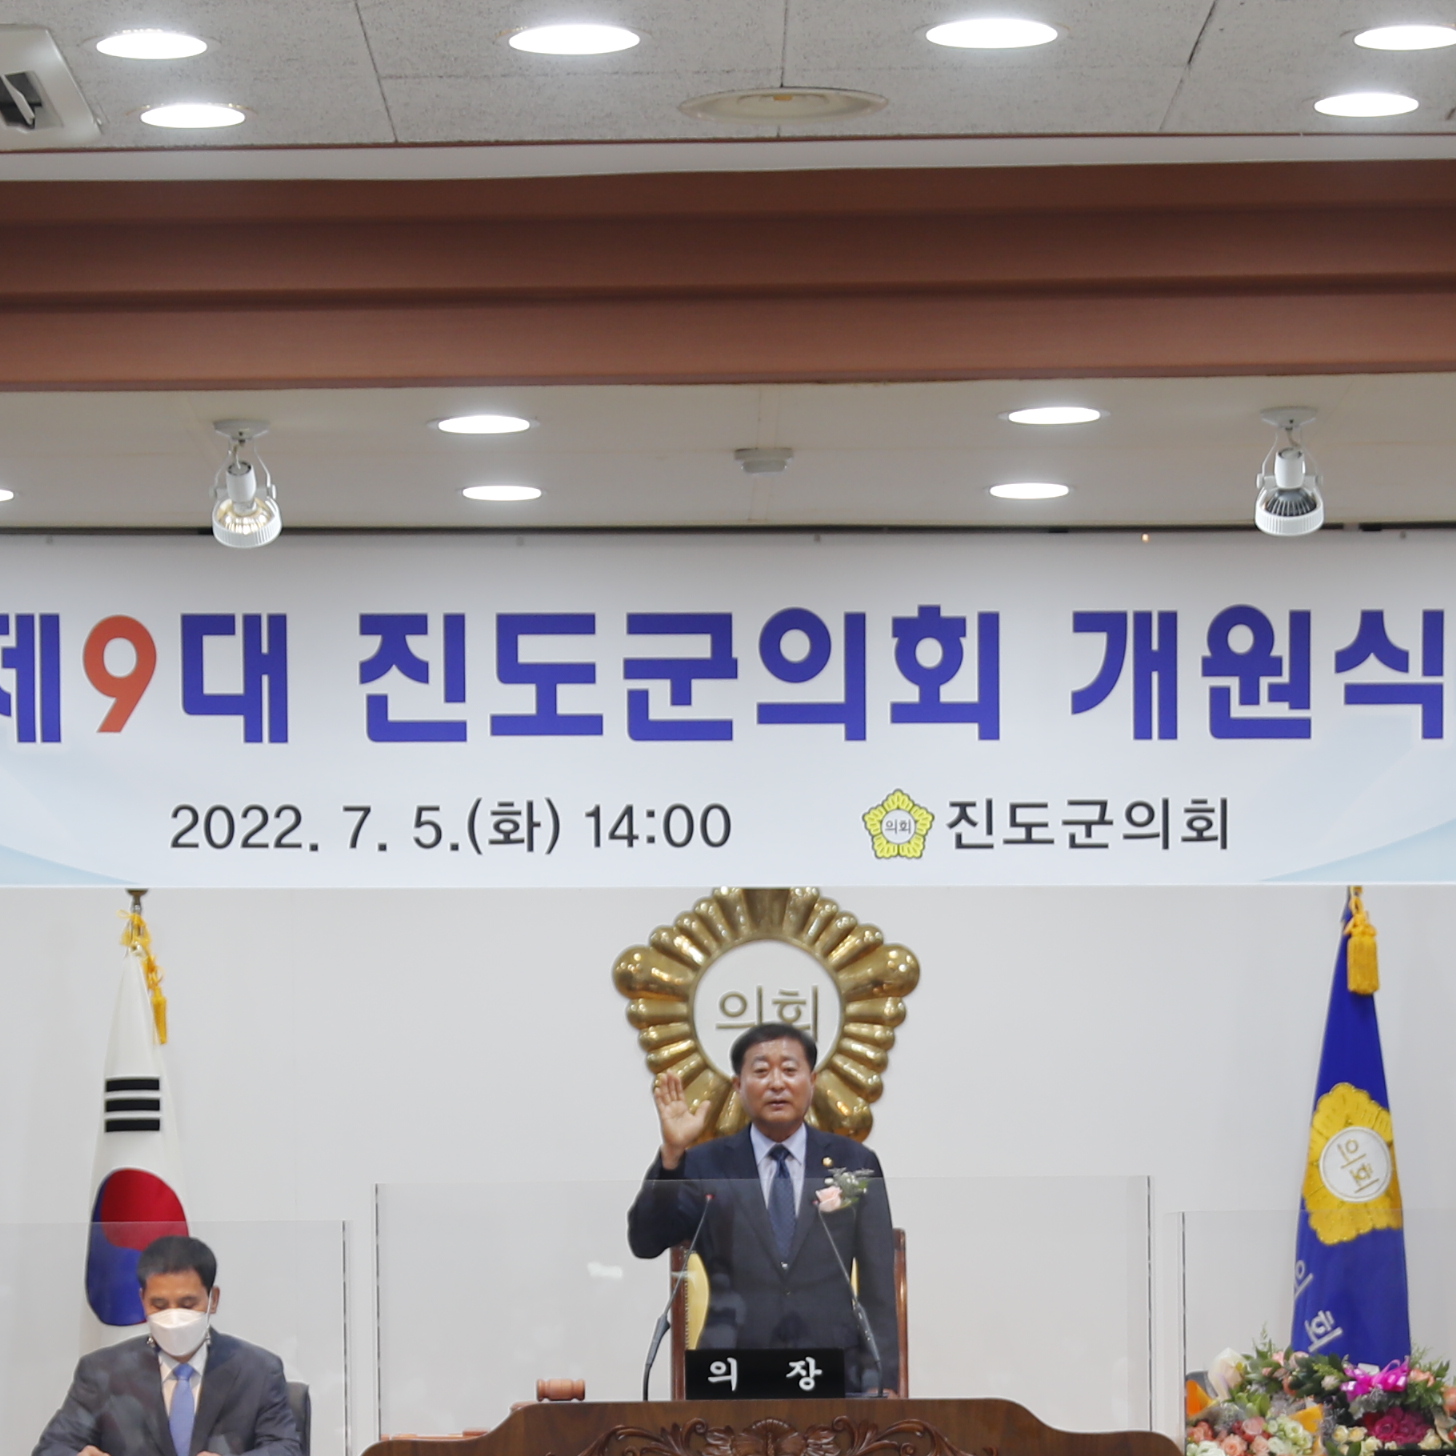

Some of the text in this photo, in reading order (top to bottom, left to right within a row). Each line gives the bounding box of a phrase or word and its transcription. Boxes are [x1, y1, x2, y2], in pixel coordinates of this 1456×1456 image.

[357, 604, 1001, 744] 진도군의회
[1070, 603, 1447, 741] 개원식
[170, 797, 731, 855] 2022. 7. 5.(화) 14:00
[885, 819, 911, 834] 의회
[946, 797, 1230, 853] 진도군의회
[716, 985, 818, 1041] 의회
[1338, 1138, 1380, 1194] 의회
